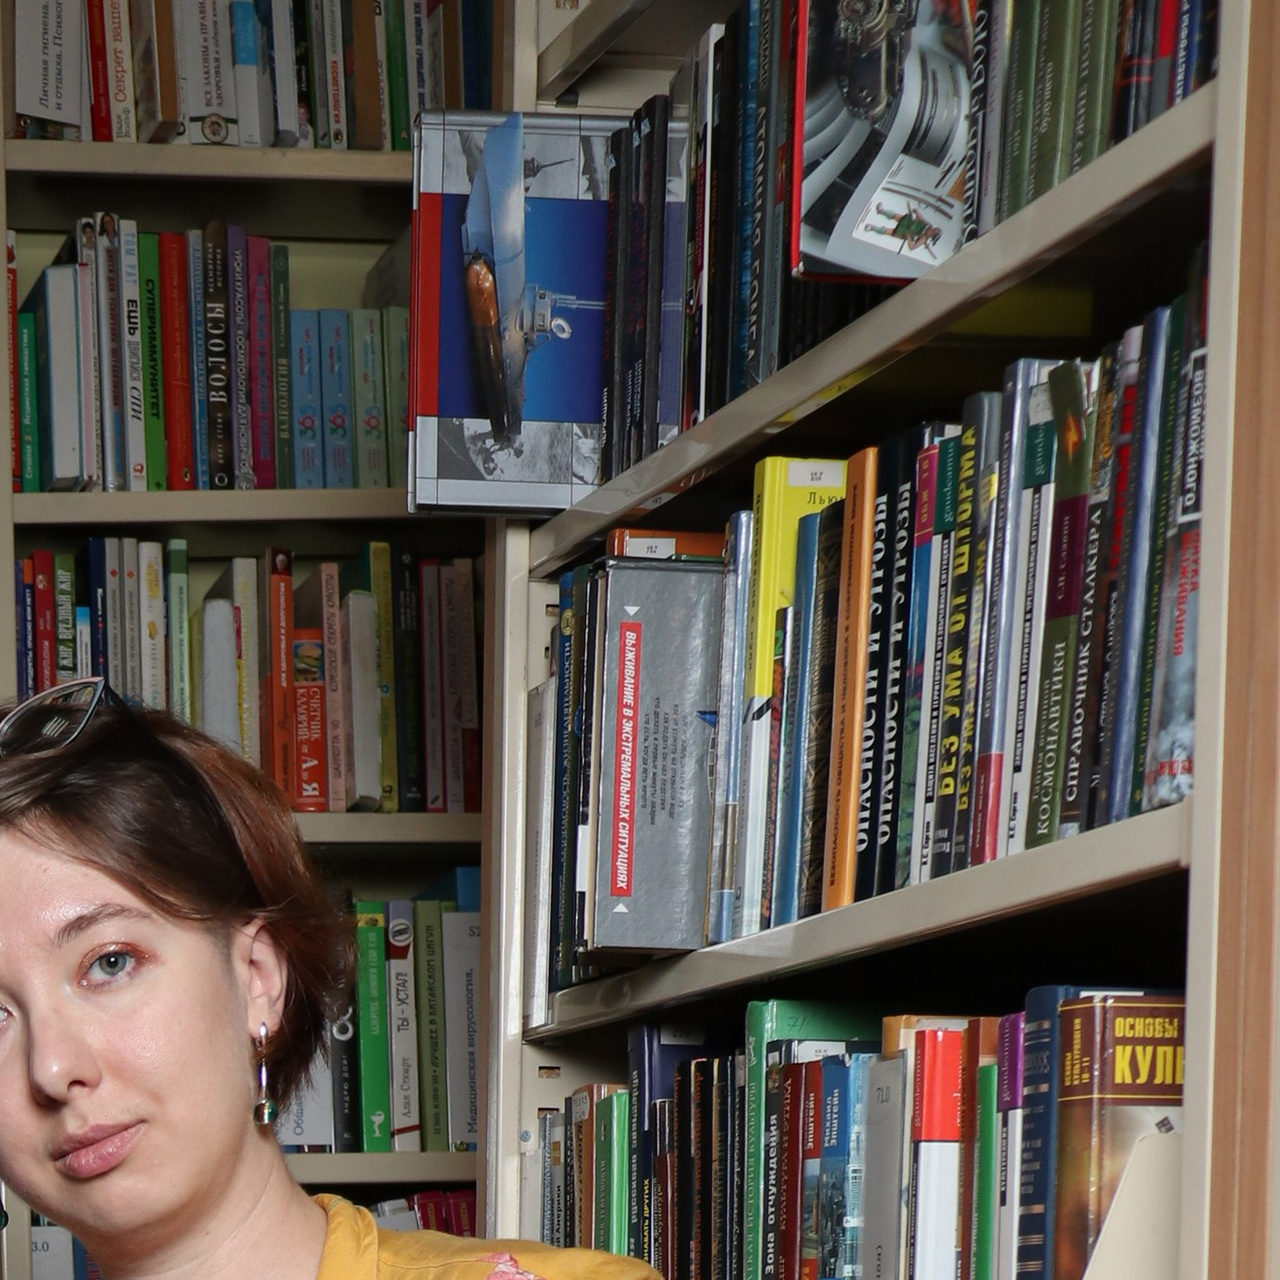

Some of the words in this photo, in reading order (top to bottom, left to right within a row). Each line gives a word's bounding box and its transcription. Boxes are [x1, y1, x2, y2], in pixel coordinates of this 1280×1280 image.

[146, 279, 160, 419] СУПЕРИММУНИТЕТ
[206, 302, 228, 404] ВОЛОСЫ
[278, 358, 290, 439] ВАЛЕОЛОГИЯ
[1184, 370, 1204, 506] ВОЗМОЖНОГО
[869, 494, 888, 614] УГРОЗЫ
[622, 631, 637, 707] ВЫЖИВАНИЕ
[866, 633, 880, 652] И
[1065, 641, 1091, 802] СПРАВОЧНИК
[1080, 507, 1104, 637] СТАЛКЕРА
[310, 687, 321, 741] СЧЕТЧИК
[623, 707, 633, 716] В
[1037, 641, 1066, 835] КОСМОНАВТИКИ
[302, 757, 319, 768] А
[302, 782, 320, 796] Я
[618, 719, 633, 818] ЭКСТРЕМАЛЬНЫХ
[855, 669, 879, 852] ОПАСНОСТИ
[616, 822, 630, 889] СИТУАЦИЯХ
[396, 972, 408, 1005] УСТАЛ!
[397, 1018, 409, 1032] ТЫ
[465, 968, 476, 1047] вирусология.
[1115, 1018, 1178, 1038] ОСНОВЫ
[467, 1052, 477, 1133] Медицинская
[824, 1096, 832, 1147] Михаил
[767, 1114, 778, 1225] отчуждения
[765, 1232, 776, 1274] Зона
